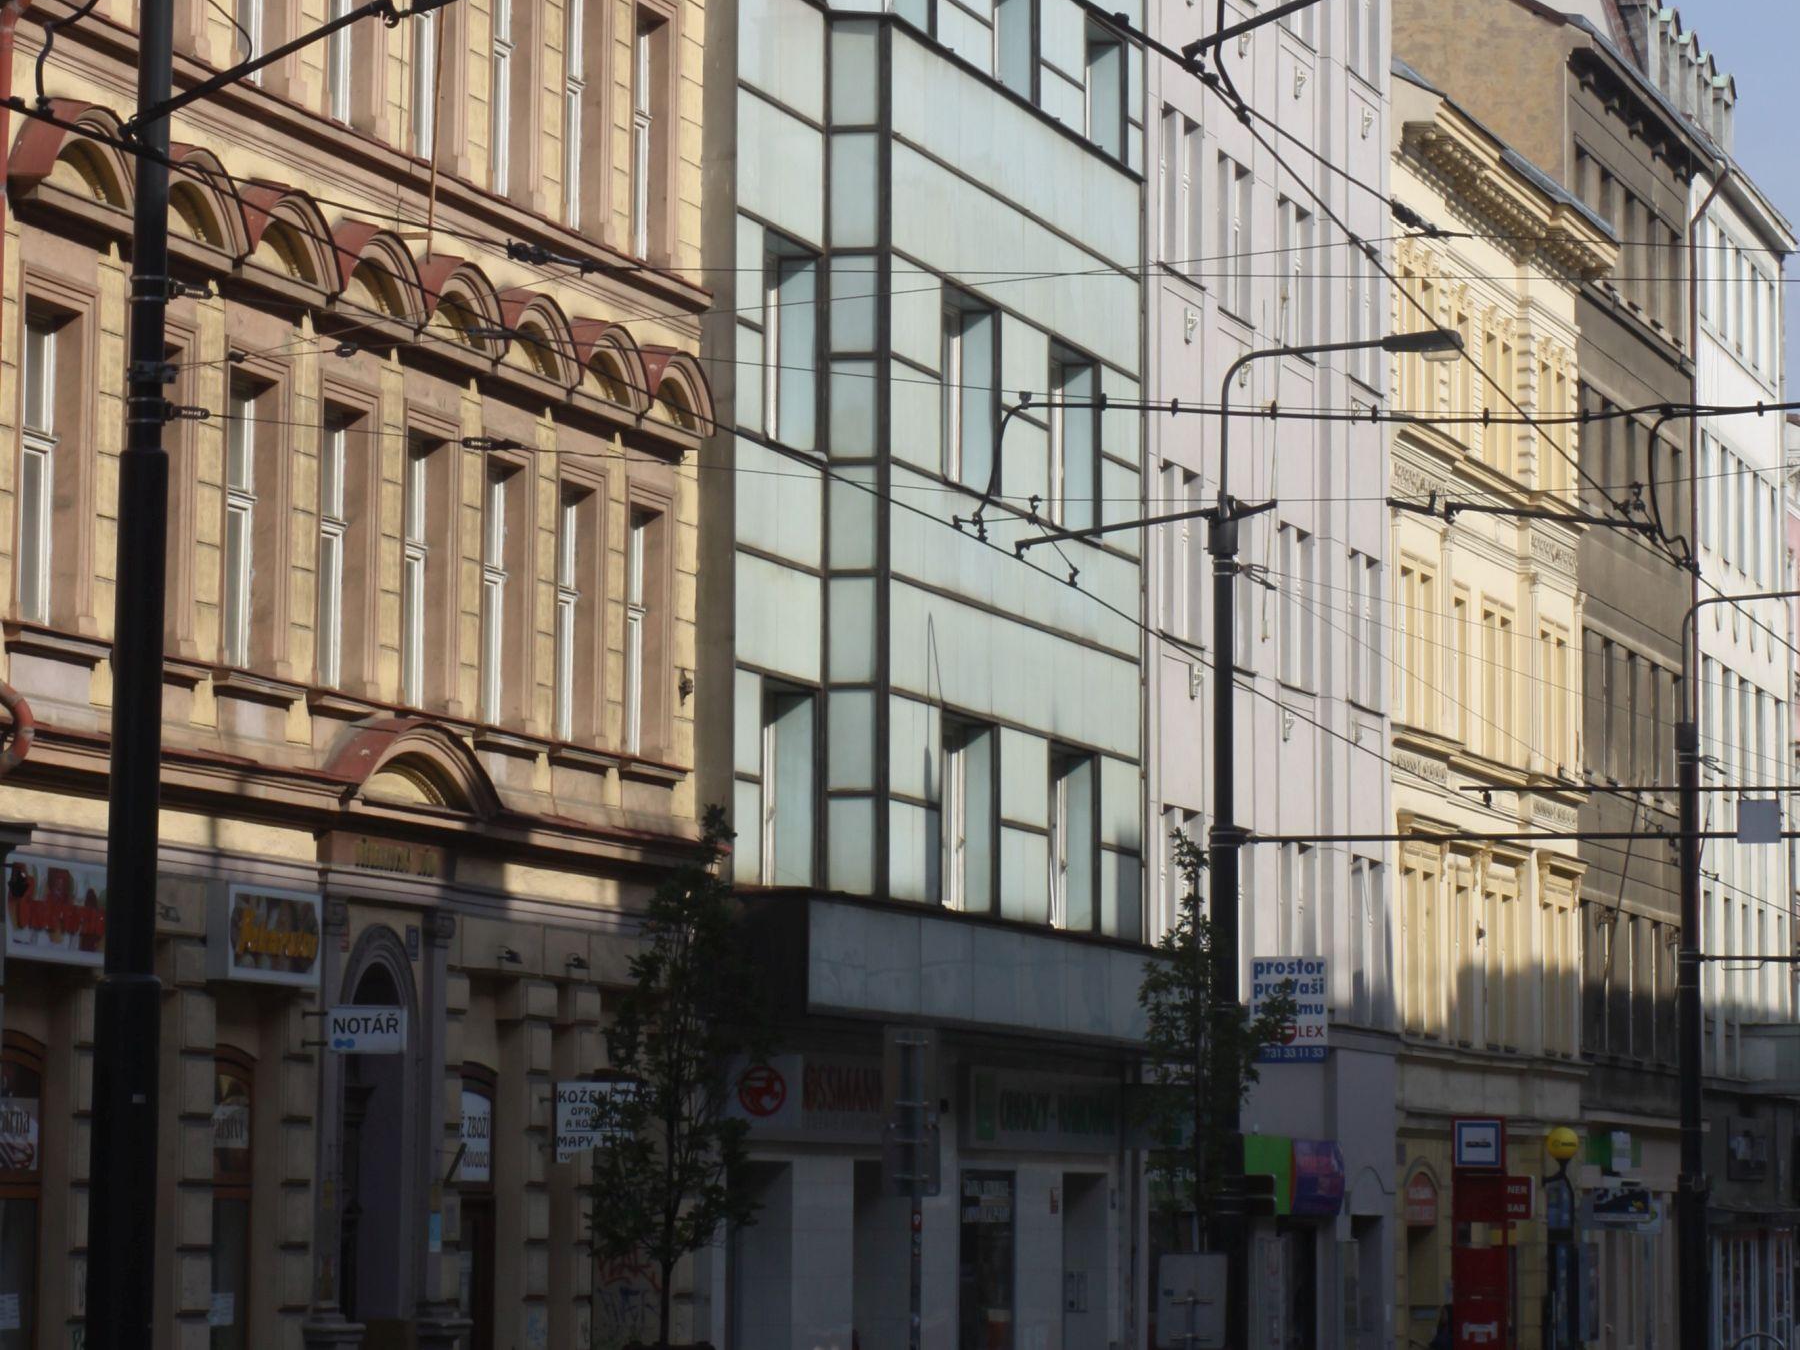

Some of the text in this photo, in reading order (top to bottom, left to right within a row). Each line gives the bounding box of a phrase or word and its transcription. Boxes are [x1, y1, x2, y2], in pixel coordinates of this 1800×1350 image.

[1253, 959, 1324, 979] prostor
[1253, 983, 1282, 999] pro
[333, 1013, 398, 1035] NOTÁŘ
[1506, 1185, 1528, 1194] NER
